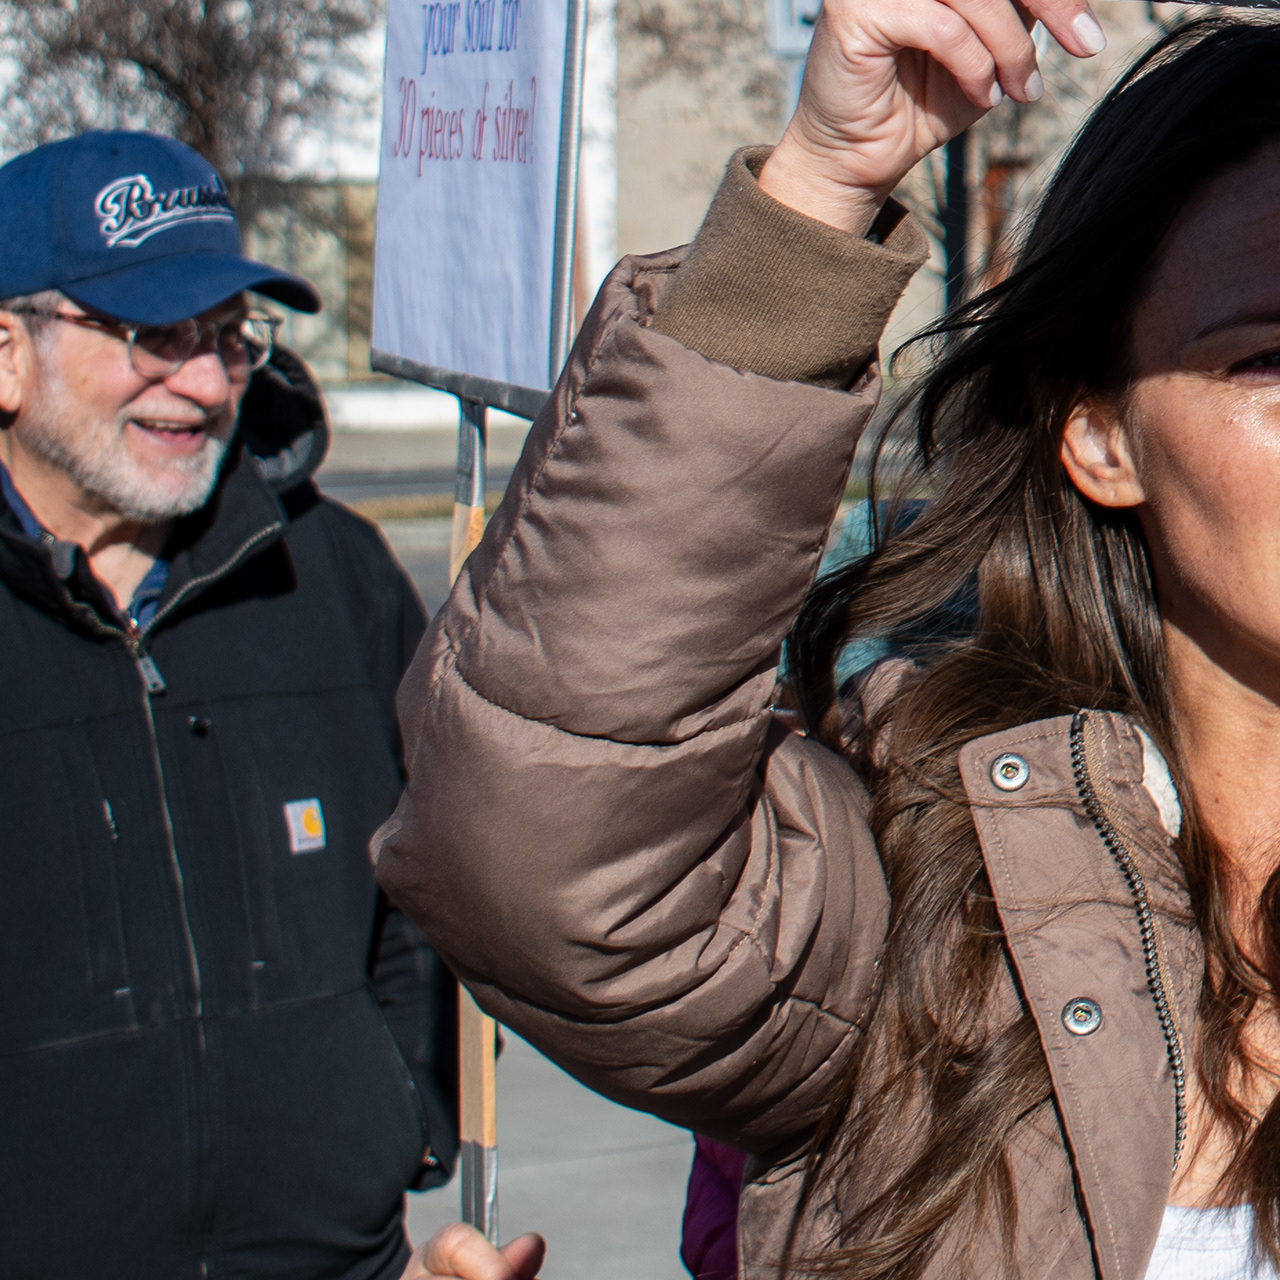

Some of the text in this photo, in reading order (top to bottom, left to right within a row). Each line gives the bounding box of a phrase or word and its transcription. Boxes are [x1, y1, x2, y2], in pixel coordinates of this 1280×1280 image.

[420, 1, 462, 75] your
[394, 75, 417, 158] 30
[417, 90, 465, 178] pieces
[472, 81, 489, 161] of
